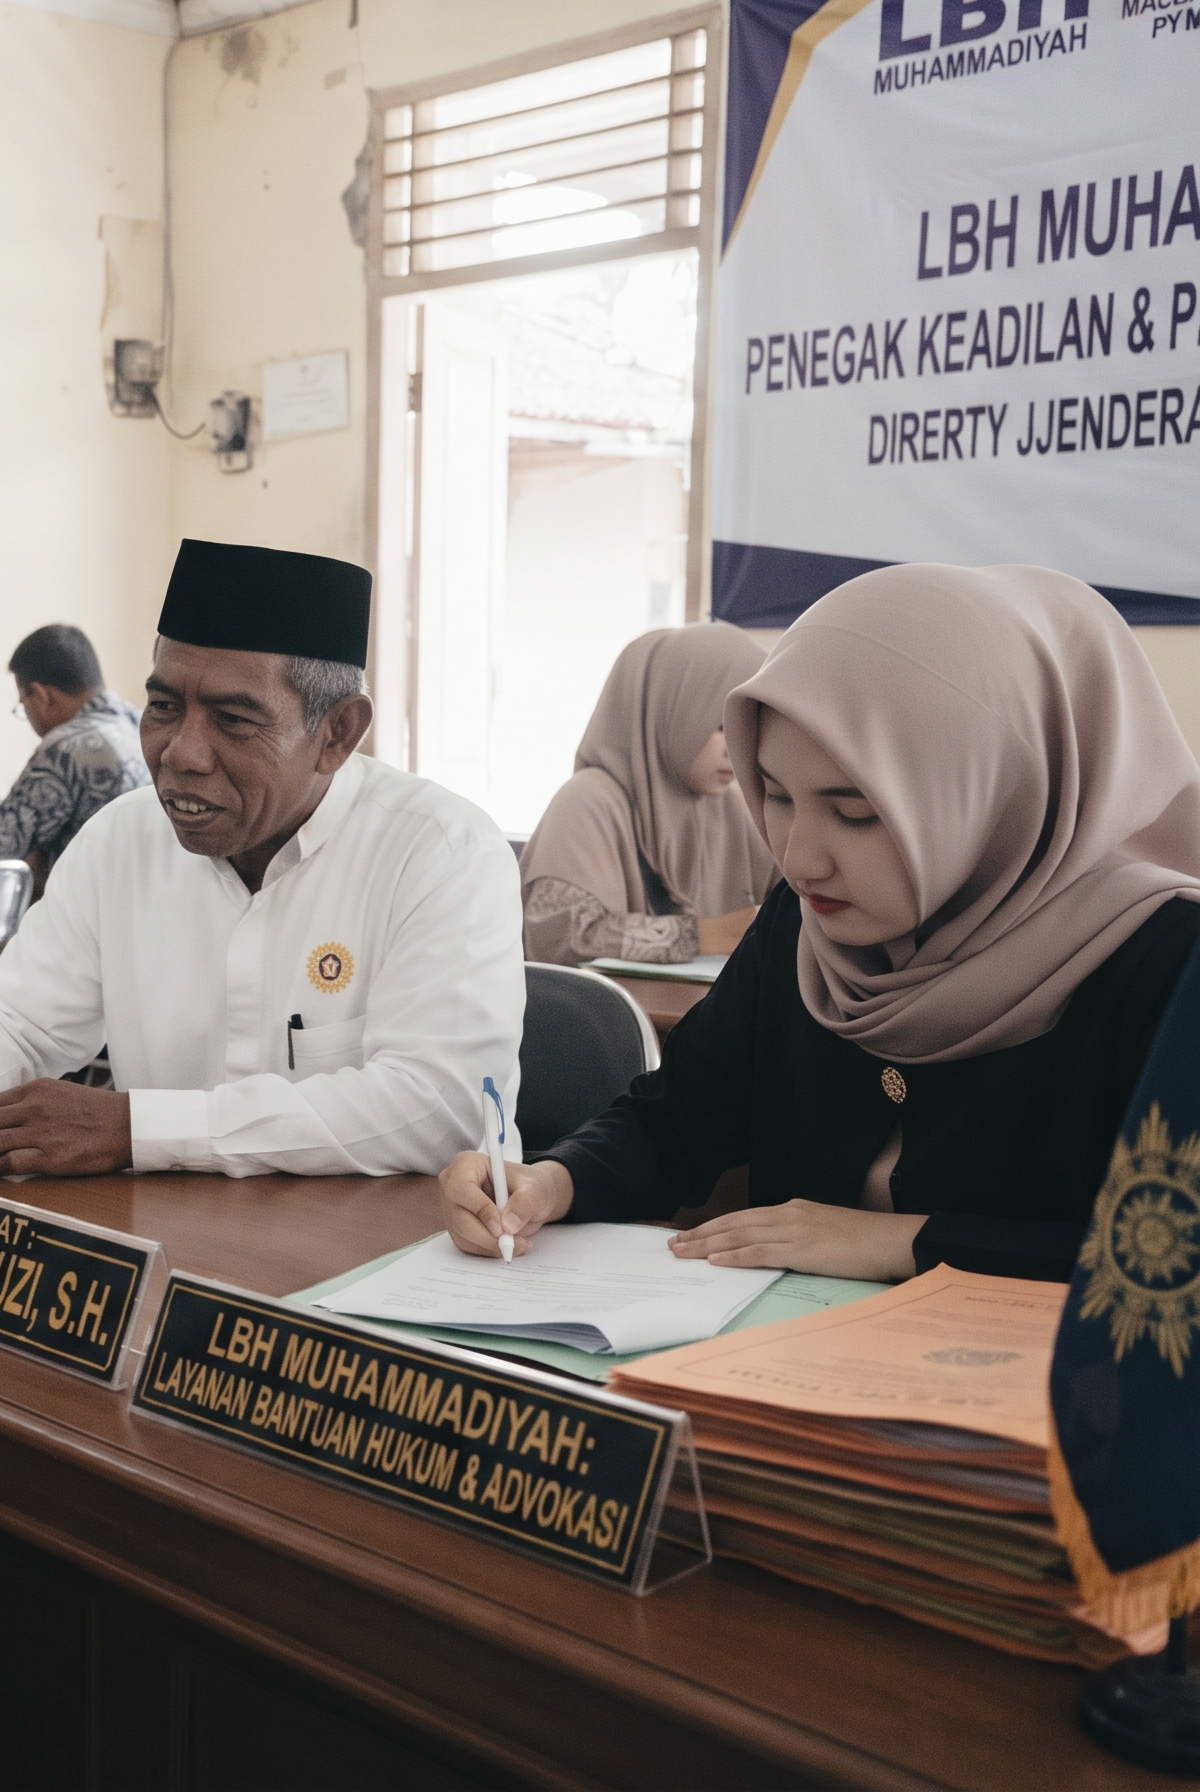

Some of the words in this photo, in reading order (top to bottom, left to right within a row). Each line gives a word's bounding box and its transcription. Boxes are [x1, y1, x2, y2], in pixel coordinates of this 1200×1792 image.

[873, 22, 1088, 95] MUHAMMADIYAH
[916, 195, 1019, 281] LBH
[1037, 164, 1200, 264] MUHA
[745, 318, 907, 394] PENEGAK
[917, 293, 1114, 376] KEADILAN
[1128, 286, 1155, 354] &
[1169, 281, 1200, 350] P
[867, 403, 1008, 466] DIRERTY
[48, 1270, 111, 1346] S.H.
[206, 1312, 279, 1371] LBH
[279, 1333, 597, 1475] MUHAMMADIYAH:
[153, 1352, 259, 1421] LAYANAN
[250, 1385, 366, 1460] BANTUAN
[363, 1423, 459, 1491] HUKUM
[458, 1454, 480, 1501] &
[480, 1464, 630, 1552] ADVOKASI
